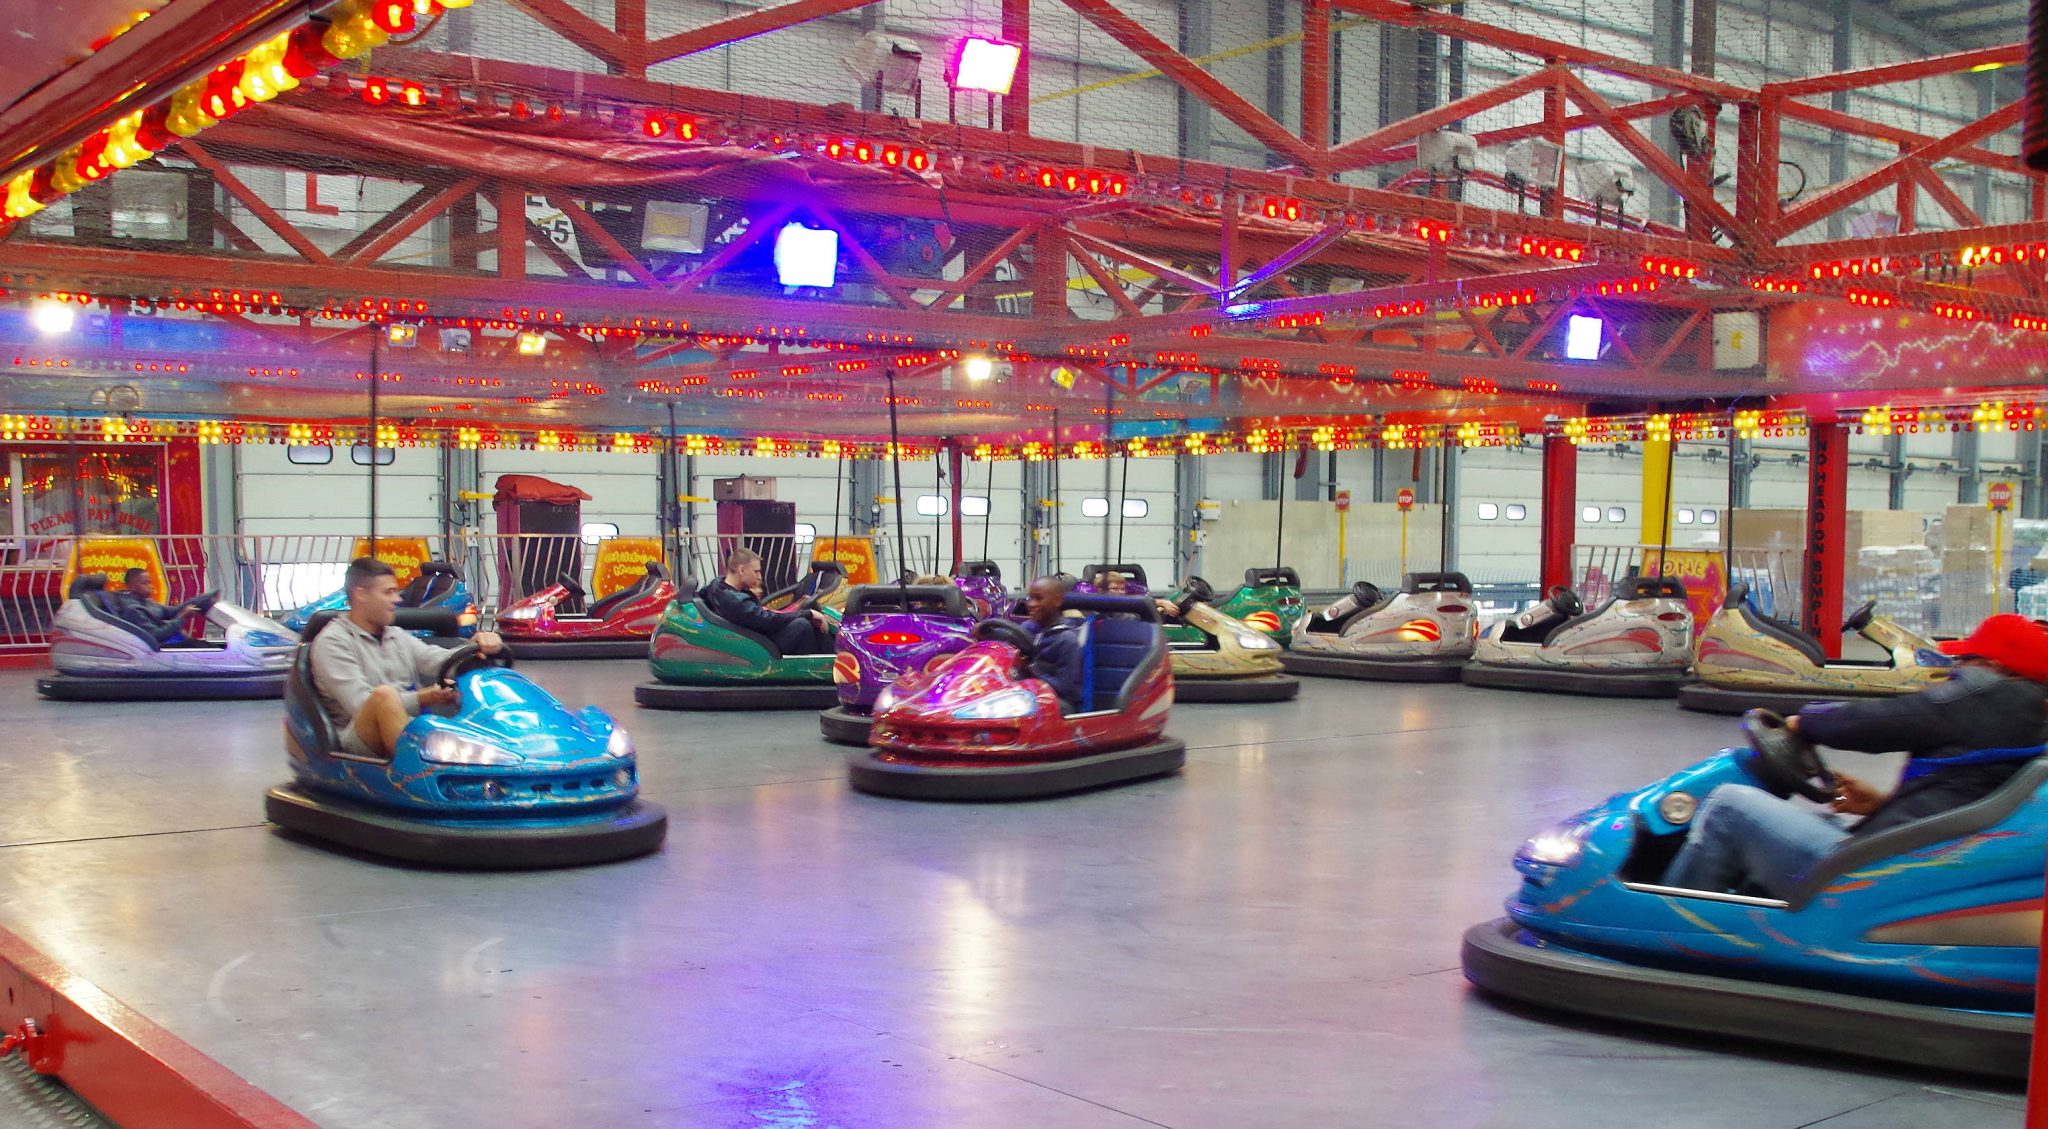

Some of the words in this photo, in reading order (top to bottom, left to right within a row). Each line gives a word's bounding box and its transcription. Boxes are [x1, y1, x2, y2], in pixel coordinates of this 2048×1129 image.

[1398, 496, 1413, 504] STOP
[1990, 491, 2010, 500] STOP
[30, 511, 77, 535] PLEAS
[87, 508, 112, 522] PAY
[118, 511, 153, 534] HERE
[1663, 559, 1709, 577] ONE
